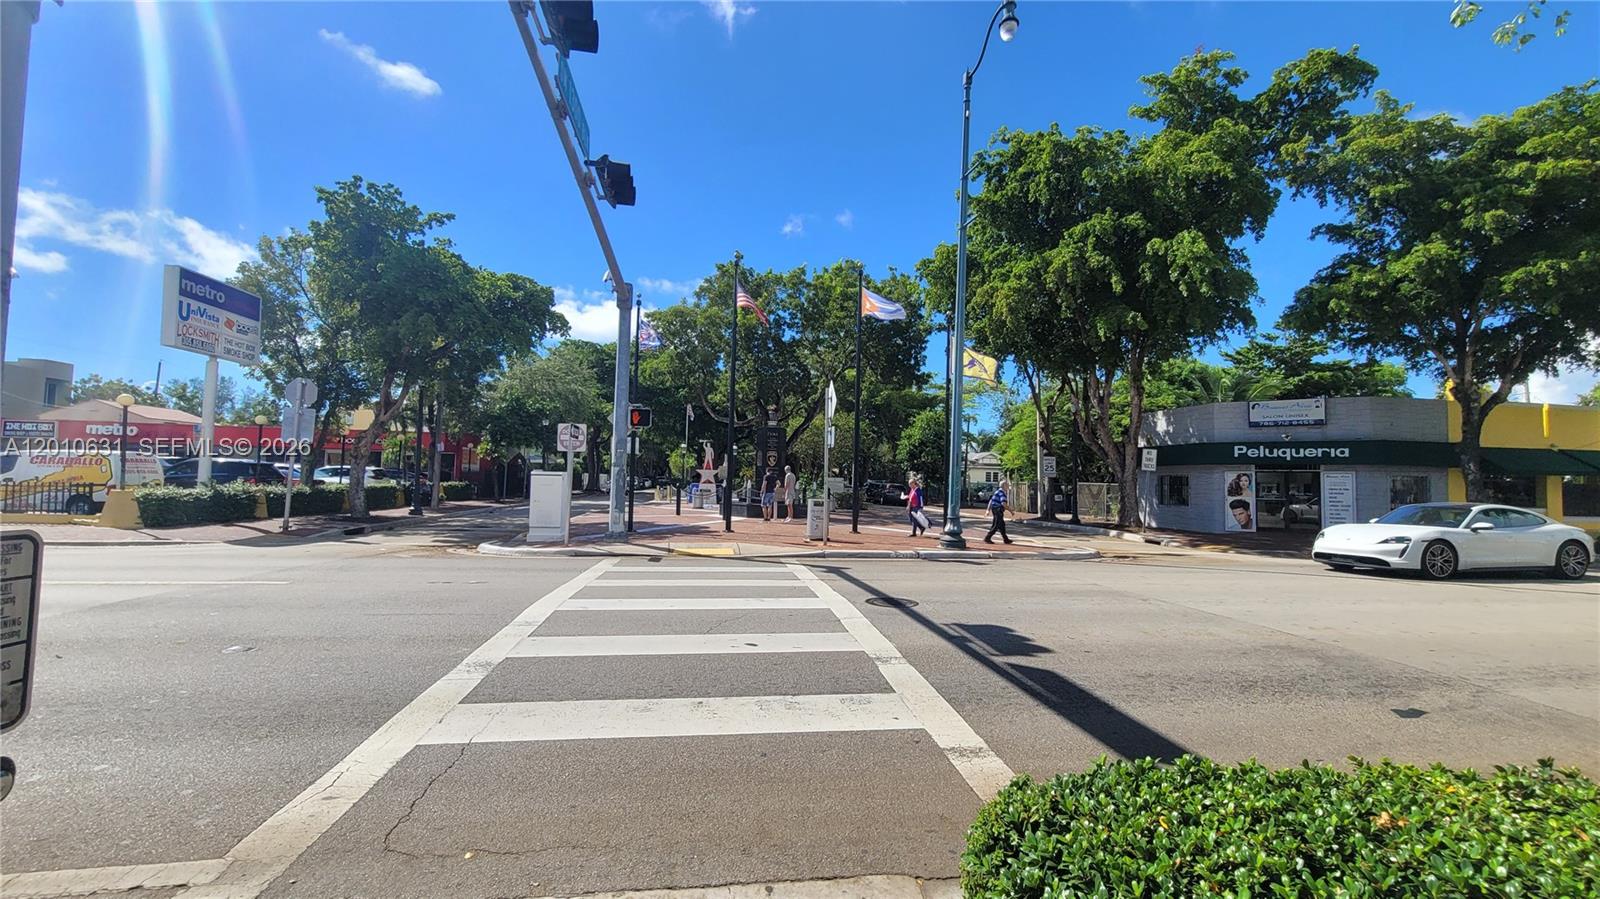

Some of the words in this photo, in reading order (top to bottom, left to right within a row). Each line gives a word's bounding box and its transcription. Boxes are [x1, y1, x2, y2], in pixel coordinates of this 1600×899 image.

[182, 279, 225, 303] metro
[178, 299, 220, 323] UniVista
[177, 323, 220, 347] LOCKSMITH
[86, 424, 139, 436] metro
[1233, 445, 1350, 461] Peluqueria
[1044, 464, 1055, 472] 25
